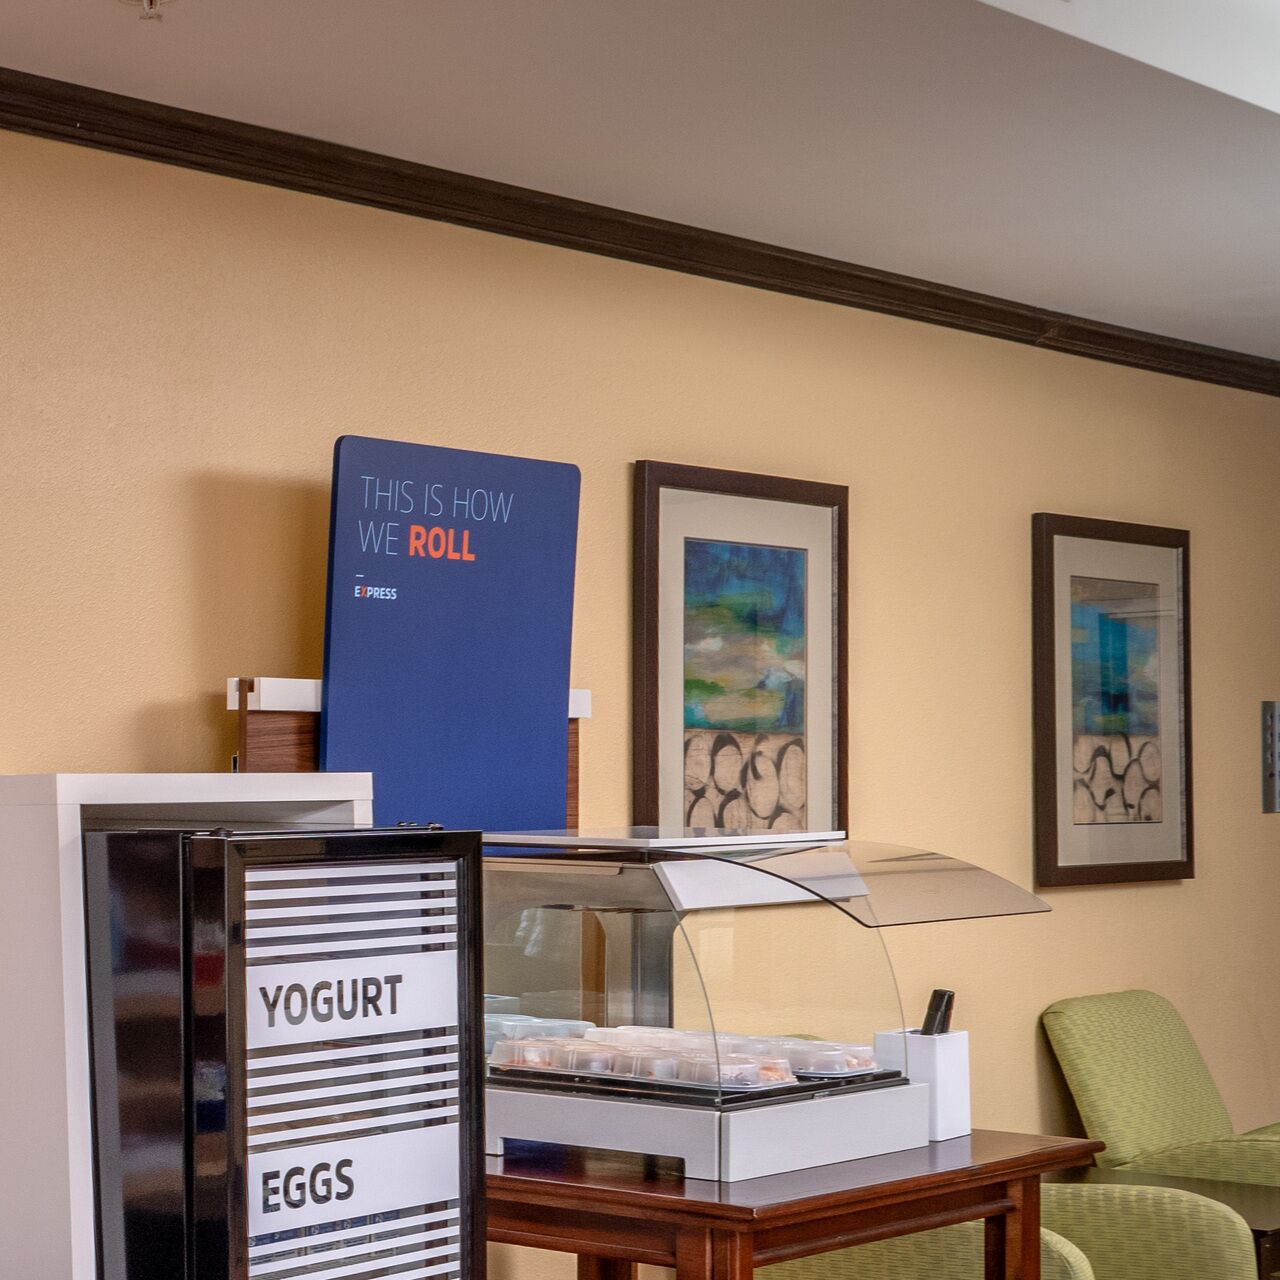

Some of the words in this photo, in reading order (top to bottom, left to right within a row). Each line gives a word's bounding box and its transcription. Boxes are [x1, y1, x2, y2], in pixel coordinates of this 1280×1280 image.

[361, 475, 414, 513] THIS
[424, 483, 443, 517] IS
[453, 487, 514, 523] HOW
[358, 520, 400, 555] WE
[408, 524, 476, 561] ROLL
[354, 586, 397, 600] EXPRESS
[258, 973, 403, 1028] YOGURT
[261, 1158, 355, 1215] EGGS
